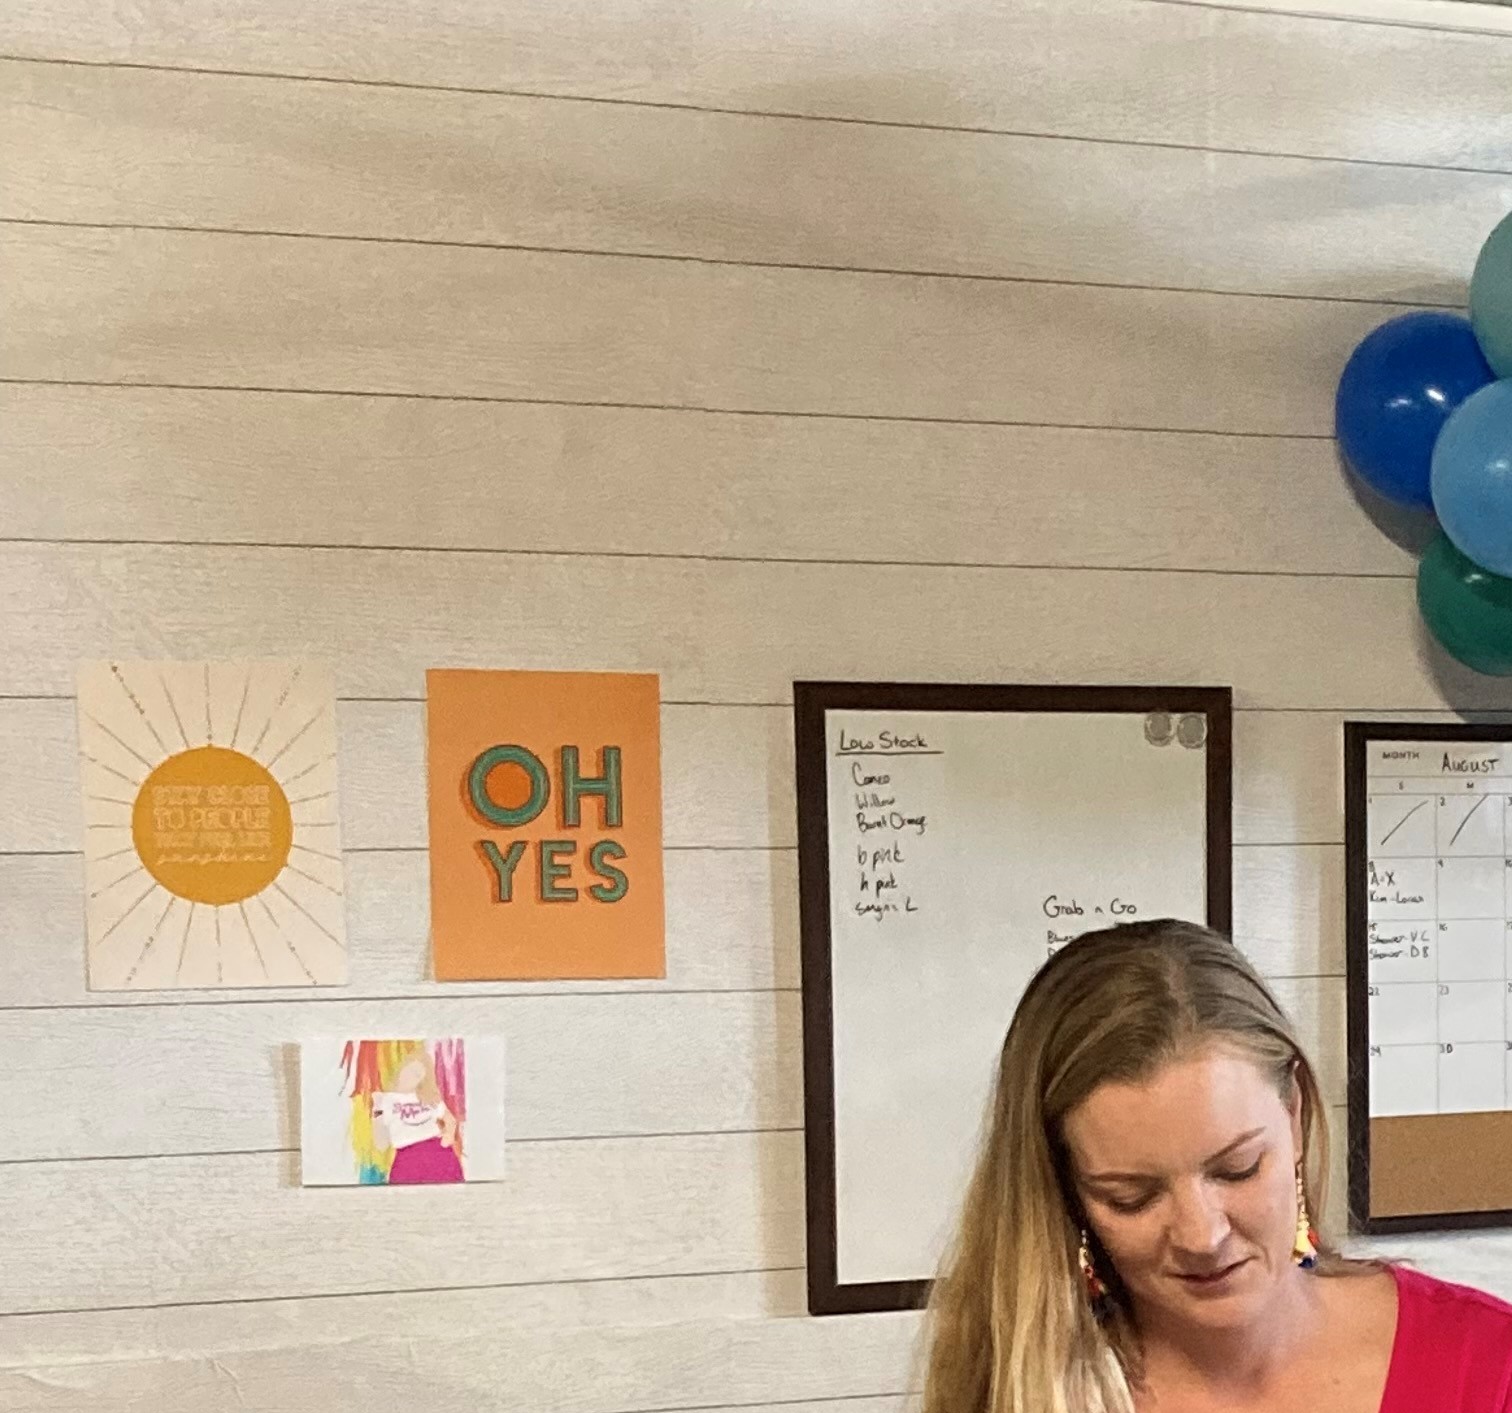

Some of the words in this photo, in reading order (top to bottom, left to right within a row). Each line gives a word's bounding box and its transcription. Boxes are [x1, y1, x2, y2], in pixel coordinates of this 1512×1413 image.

[839, 729, 875, 751] Low
[879, 730, 928, 749] Stock
[1382, 751, 1420, 761] MONTH
[1441, 753, 1500, 773] AUGUST
[464, 744, 624, 828] OH
[477, 839, 629, 903] YES
[905, 896, 919, 912] L
[1042, 894, 1085, 918] Grab
[1110, 897, 1138, 915] Go
